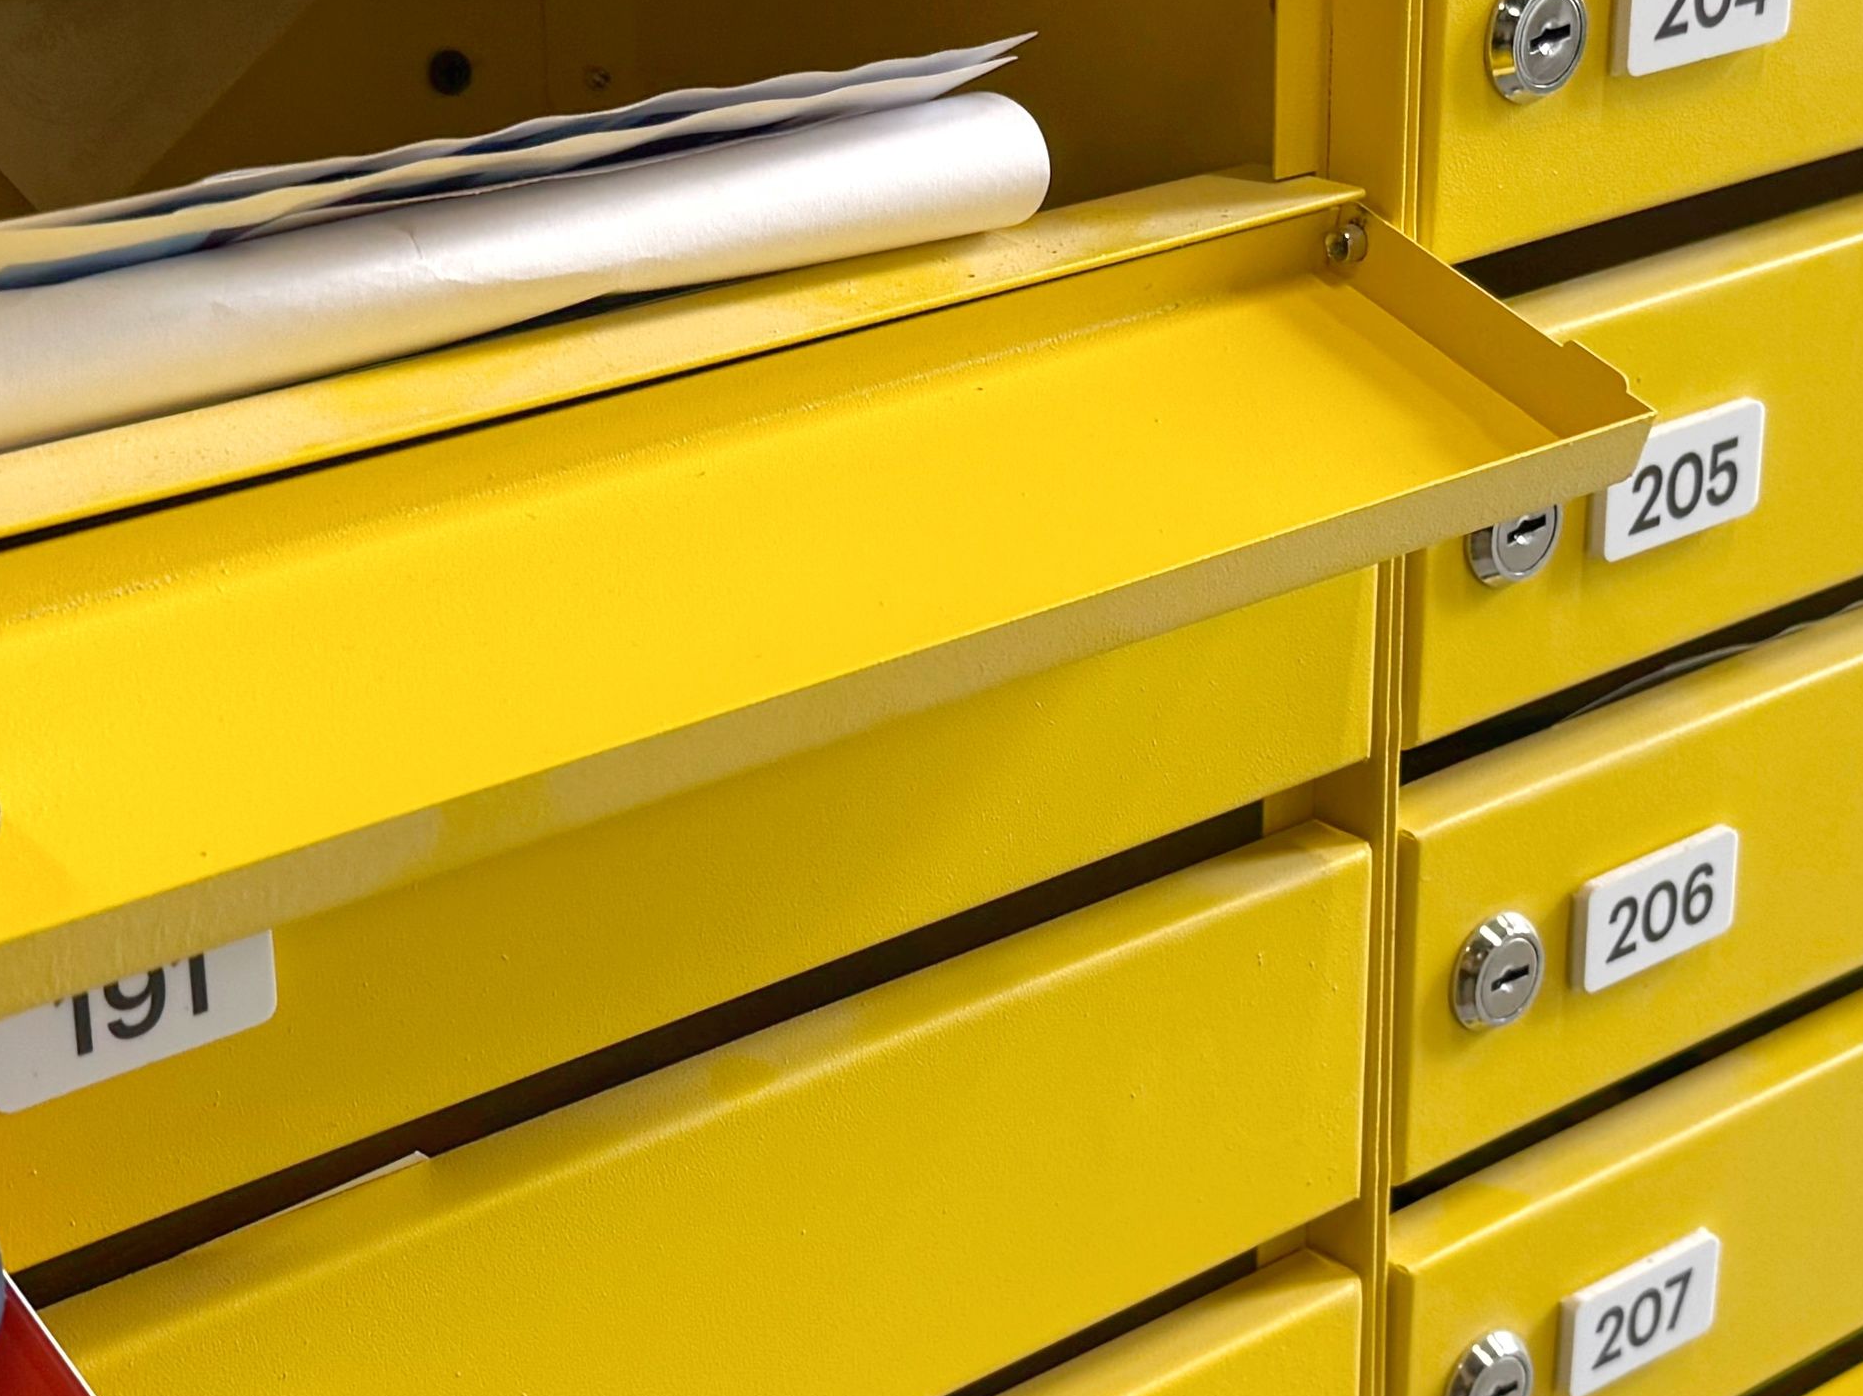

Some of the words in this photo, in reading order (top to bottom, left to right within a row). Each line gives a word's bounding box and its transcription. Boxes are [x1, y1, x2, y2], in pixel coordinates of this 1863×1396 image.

[1629, 437, 1738, 536] 205
[1606, 863, 1714, 963] 206
[54, 952, 208, 1056] 191
[1592, 1268, 1692, 1370] 207
